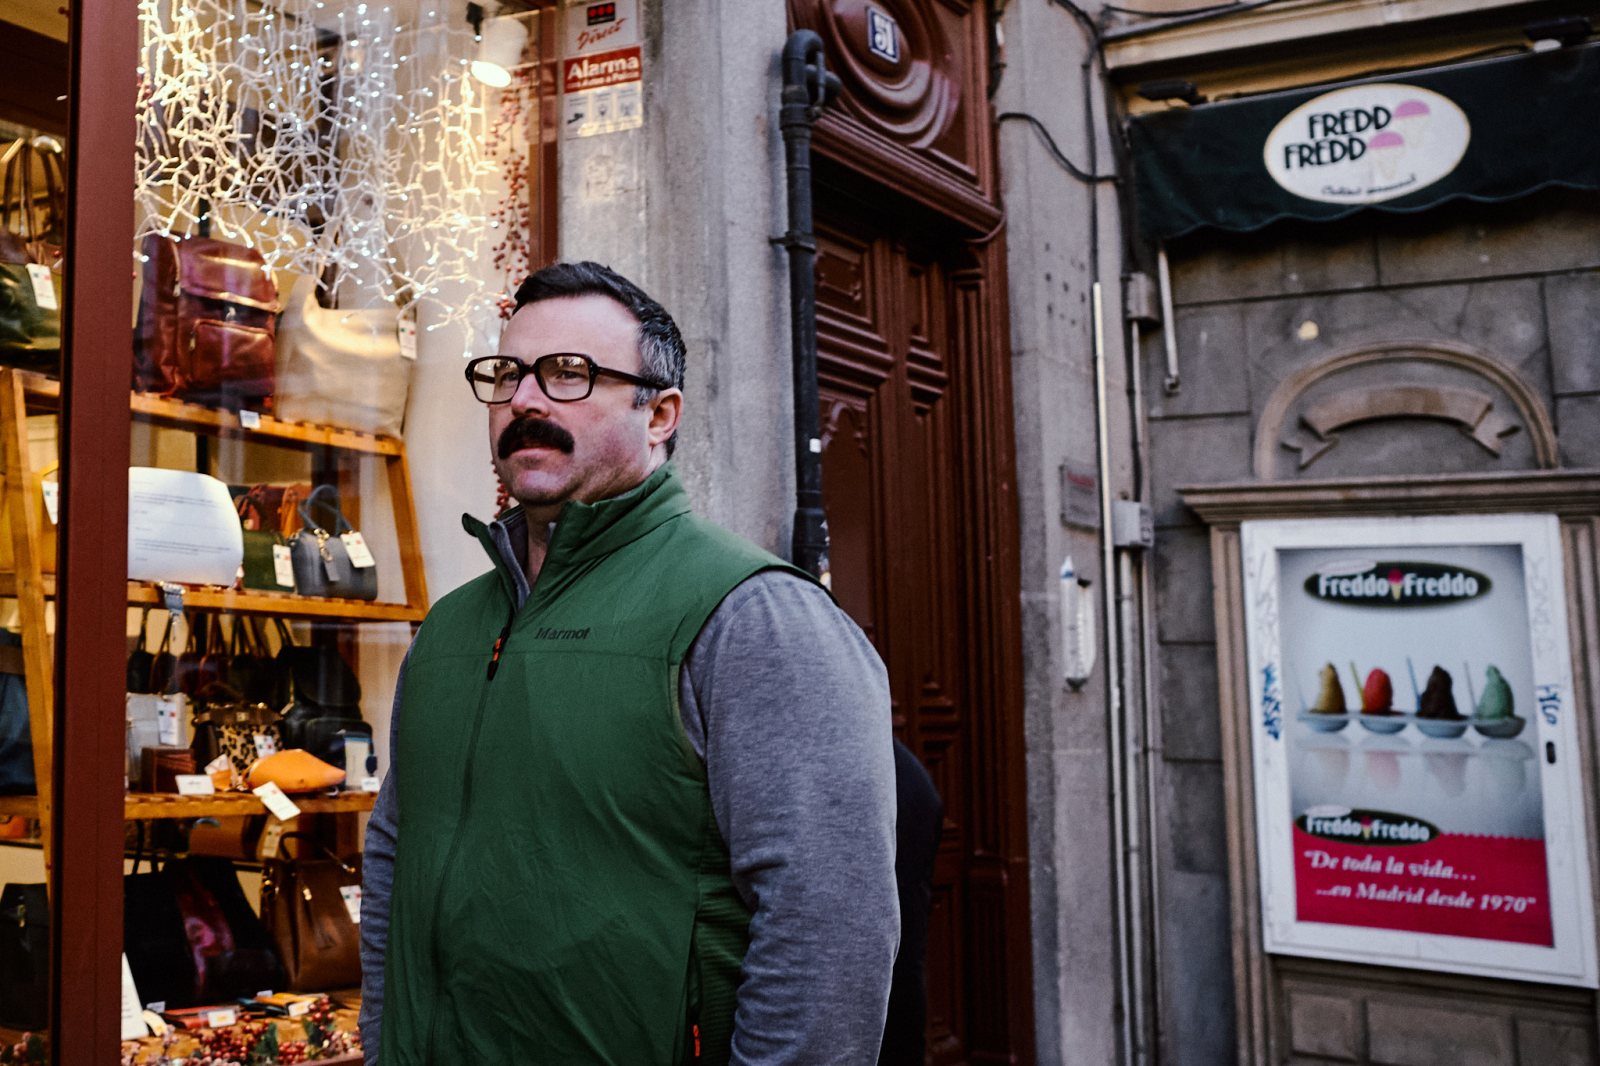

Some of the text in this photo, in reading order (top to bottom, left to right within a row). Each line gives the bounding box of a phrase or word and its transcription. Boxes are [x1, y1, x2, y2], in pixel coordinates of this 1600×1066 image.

[567, 56, 639, 80] Alarma
[1318, 572, 1479, 597] Freddo Freddo
[534, 627, 591, 640] Marmot
[1306, 817, 1430, 842] Freddo Freddo
[1342, 854, 1382, 875] toda
[1385, 856, 1405, 875] la
[1355, 882, 1423, 905] Madrid
[1425, 890, 1475, 909] desde
